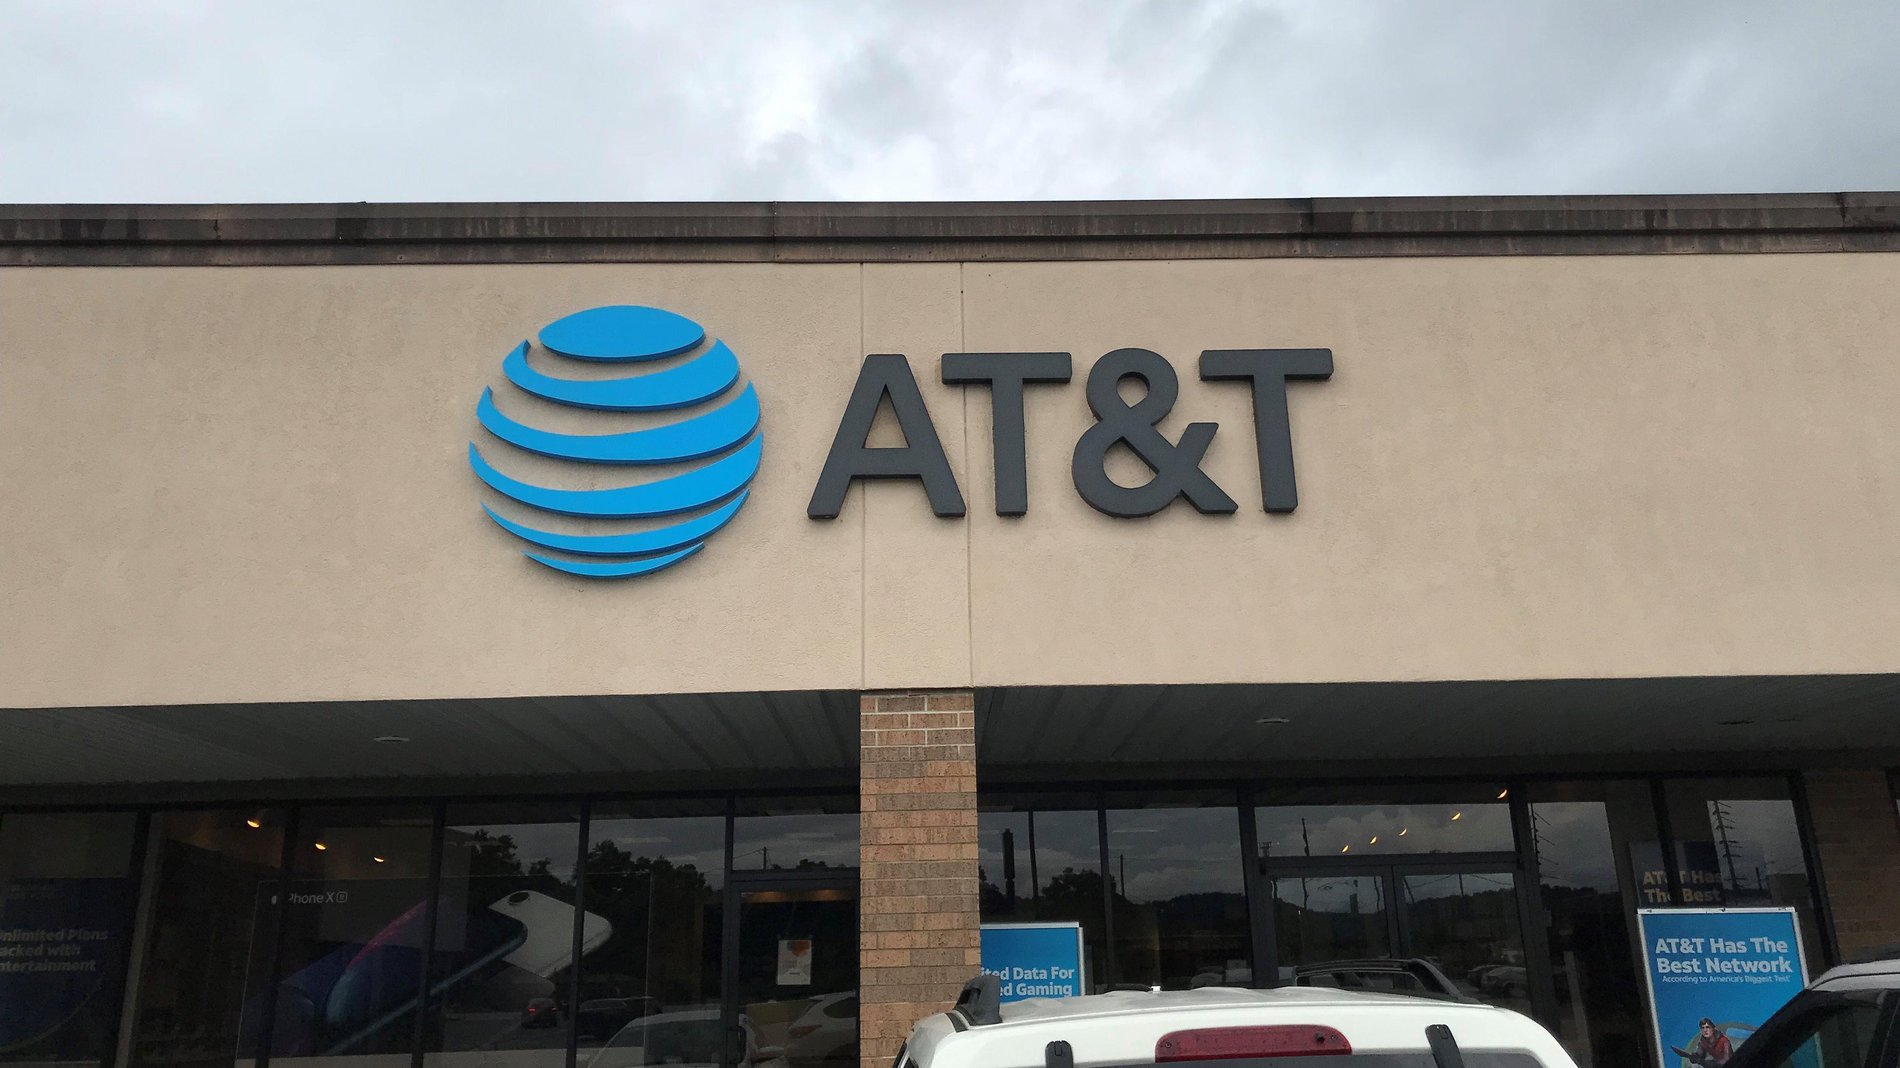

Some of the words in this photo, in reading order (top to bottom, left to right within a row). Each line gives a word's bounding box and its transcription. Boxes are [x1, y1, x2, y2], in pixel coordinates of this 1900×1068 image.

[807, 347, 1334, 519] AT&T
[1643, 869, 1686, 885] ATT
[1691, 869, 1722, 885] Has
[1682, 887, 1723, 903] Best
[0, 928, 64, 942] nlimited
[67, 928, 109, 942] Plans
[0, 944, 44, 958] acked
[48, 944, 81, 957] with
[1655, 938, 1705, 954] AT&T
[1709, 937, 1748, 954] Has
[1750, 936, 1789, 953] The
[0, 959, 97, 974] ntertainment
[1656, 957, 1703, 973] Best
[1705, 956, 1794, 973] Network
[1013, 967, 1047, 980] Data
[1051, 966, 1075, 980] For
[1662, 975, 1699, 984] According
[1708, 975, 1744, 983] America's
[1745, 975, 1773, 985] Biggest
[1016, 981, 1073, 997] Gaming
